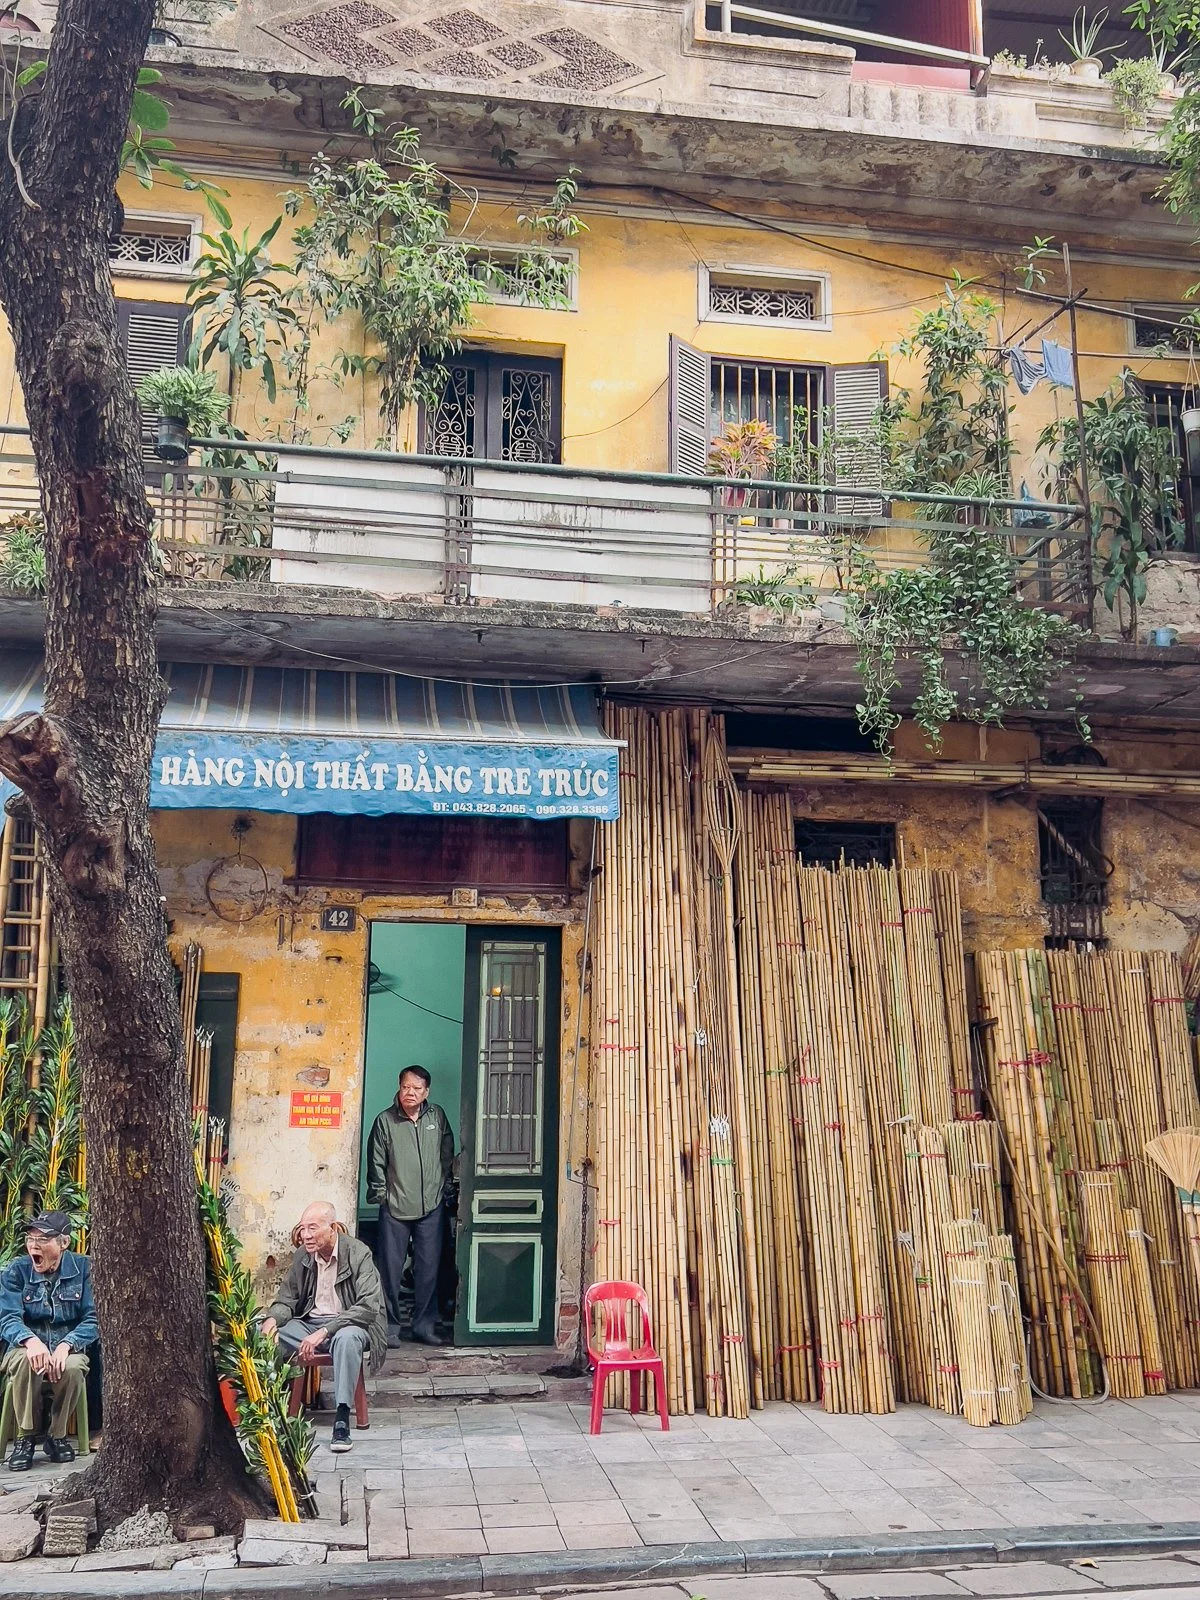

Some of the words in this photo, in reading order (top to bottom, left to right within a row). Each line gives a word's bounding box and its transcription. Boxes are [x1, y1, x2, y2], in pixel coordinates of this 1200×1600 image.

[160, 749, 246, 787] HÀNG
[253, 752, 306, 797] NỘI
[312, 750, 390, 791] THẤT
[396, 750, 473, 794] BẰNG
[479, 767, 532, 796] TRE
[538, 761, 609, 797] TRÚC
[452, 802, 526, 814] 043.828.2065
[328, 910, 349, 927] 42
